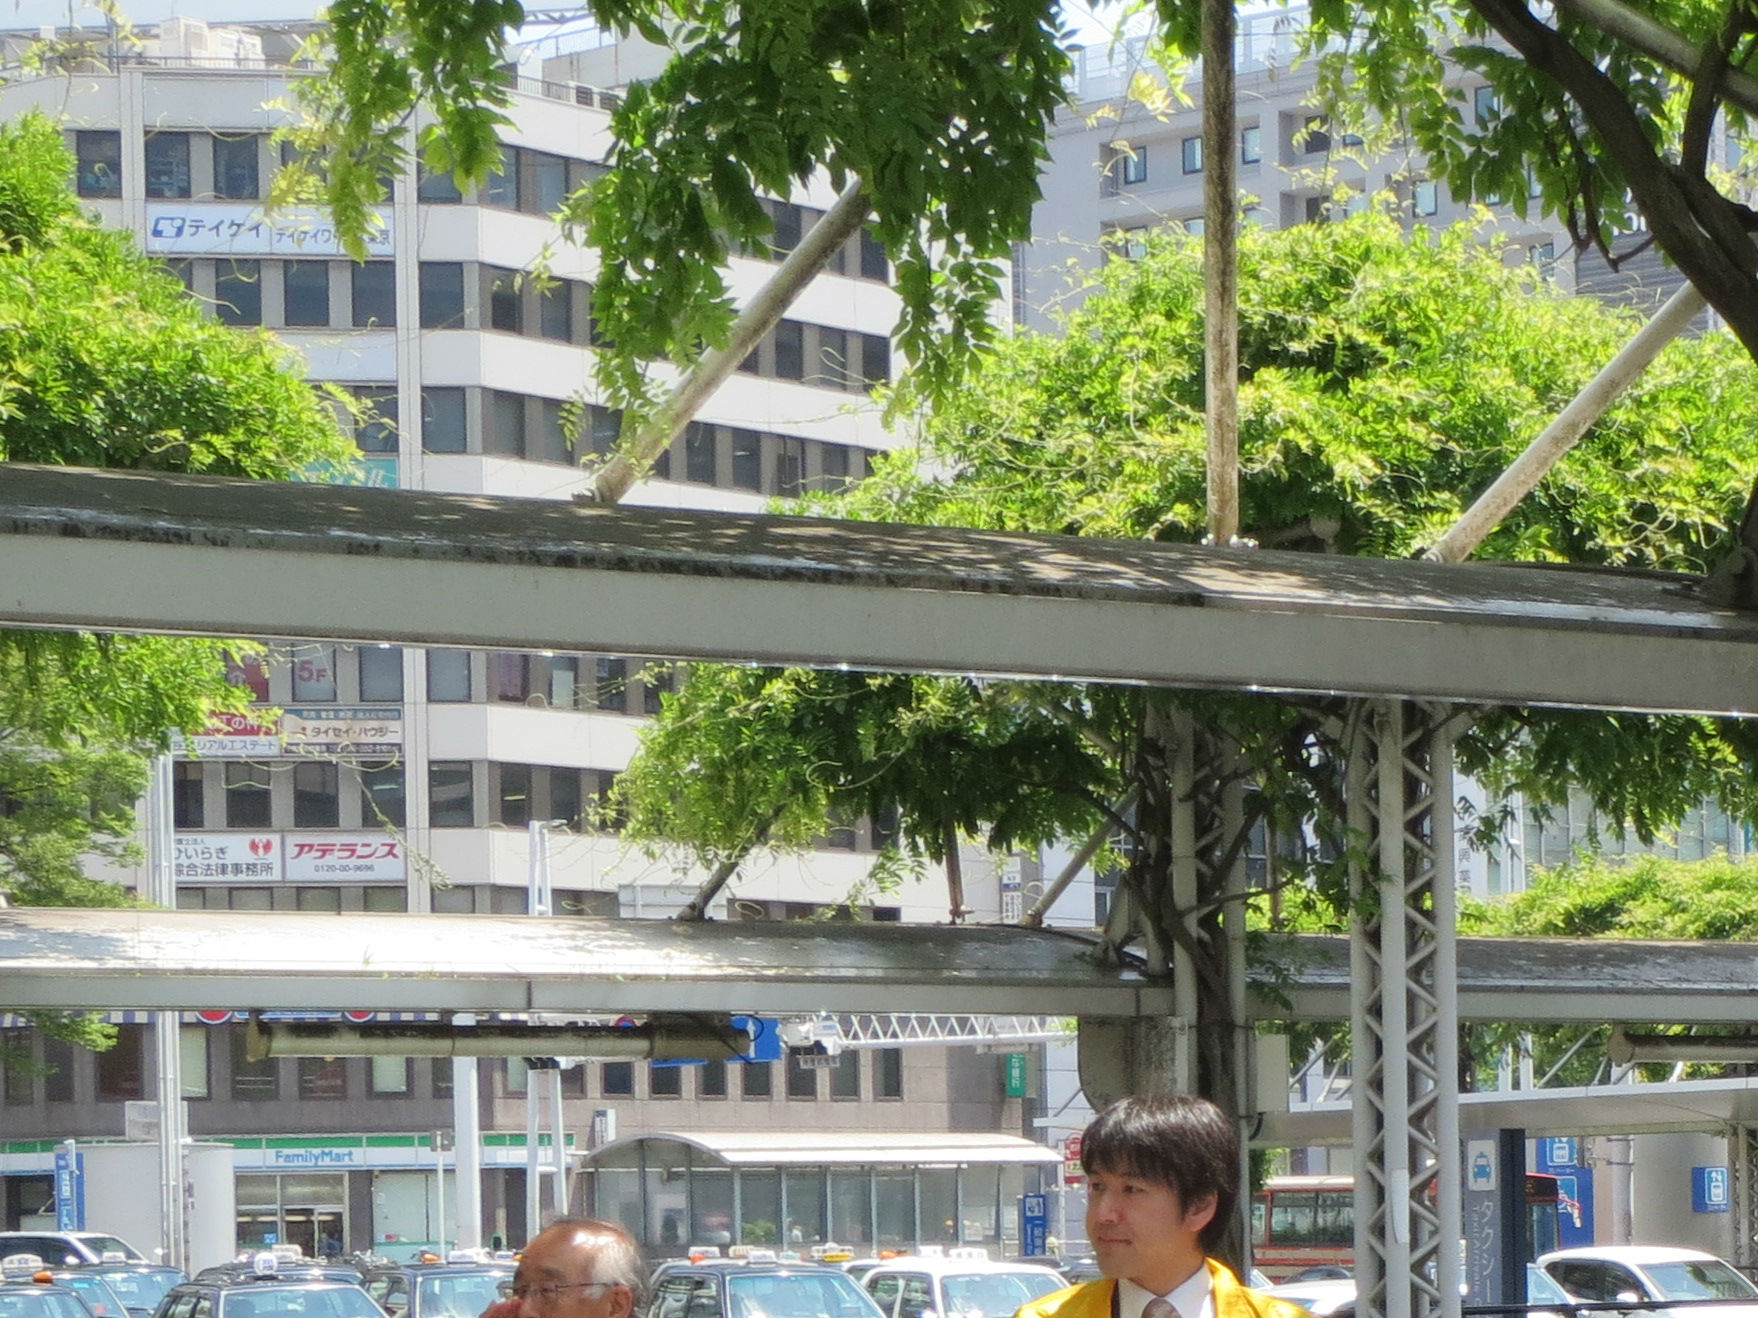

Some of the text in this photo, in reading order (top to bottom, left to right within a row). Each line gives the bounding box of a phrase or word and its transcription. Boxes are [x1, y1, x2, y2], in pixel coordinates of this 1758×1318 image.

[188, 219, 263, 237] テイケイ
[275, 1149, 354, 1166] FamilyMart
